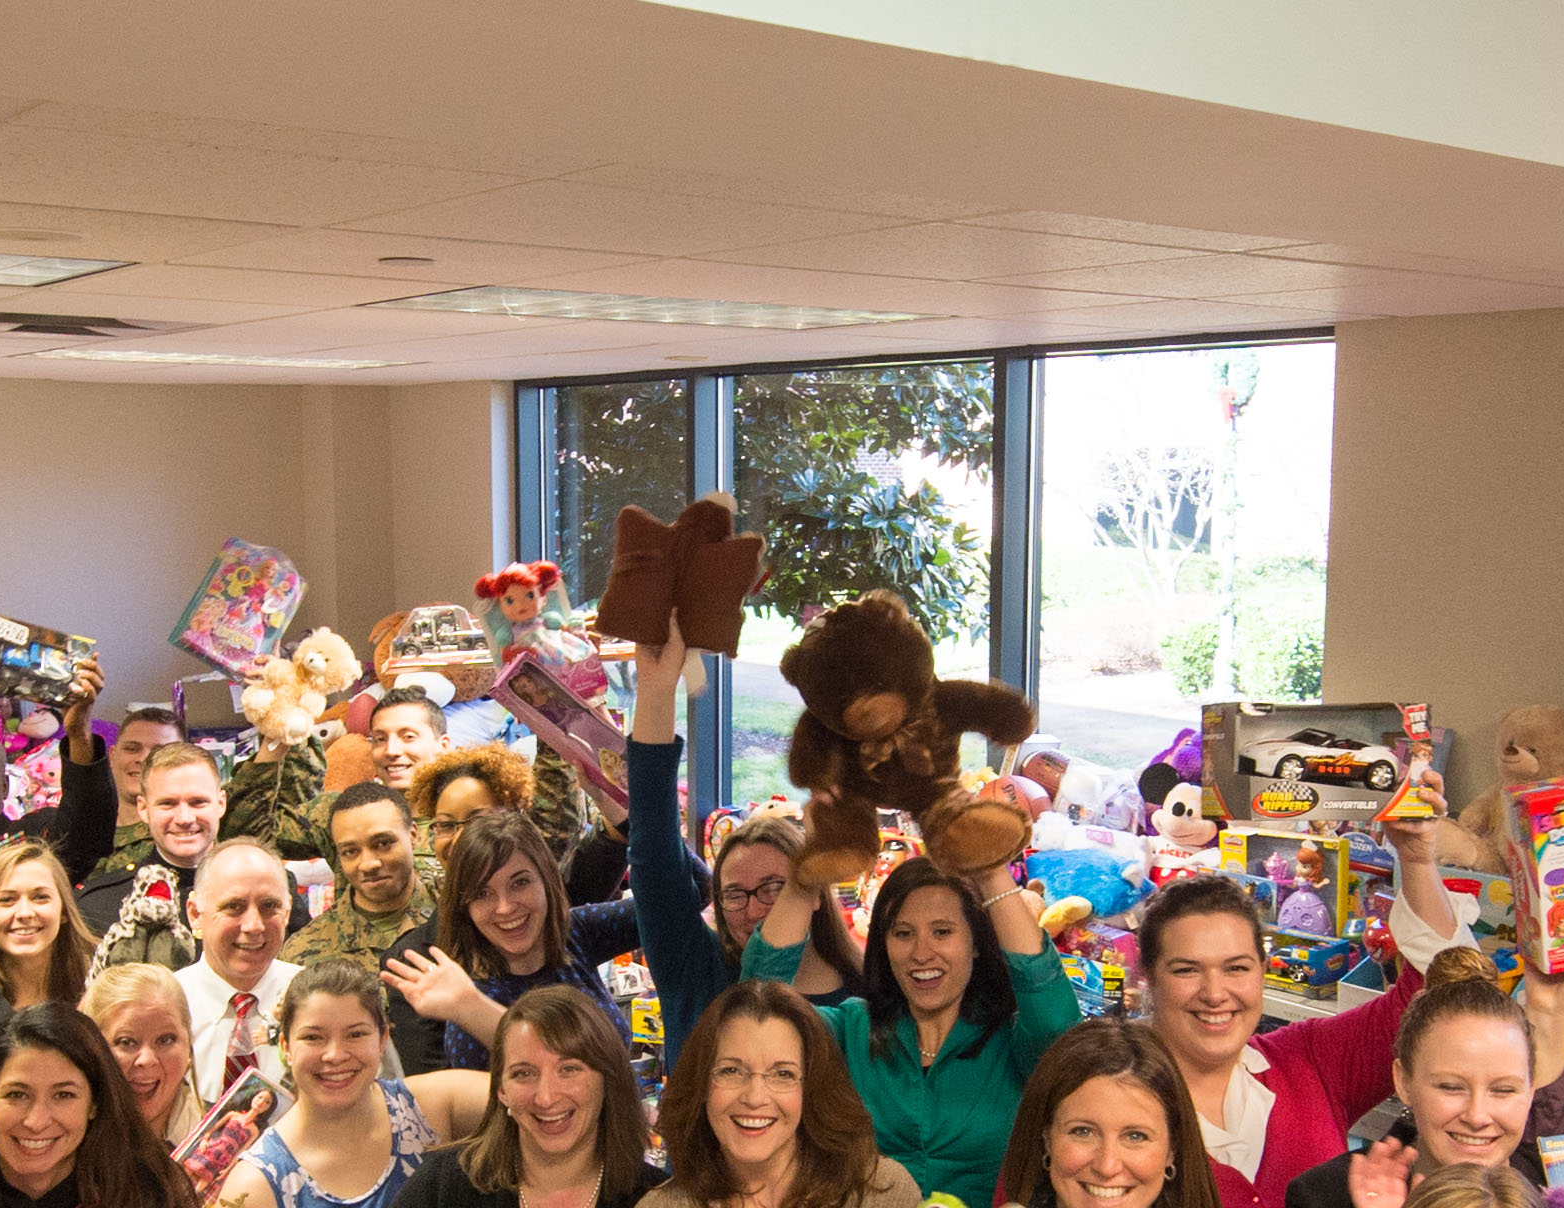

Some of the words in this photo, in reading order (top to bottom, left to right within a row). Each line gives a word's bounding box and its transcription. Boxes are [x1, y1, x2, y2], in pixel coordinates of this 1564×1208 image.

[1408, 711, 1427, 722] TRY
[1261, 792, 1294, 802] ROAD
[1262, 801, 1310, 811] RIPPERS
[1322, 801, 1377, 809] CONVERTIBLES
